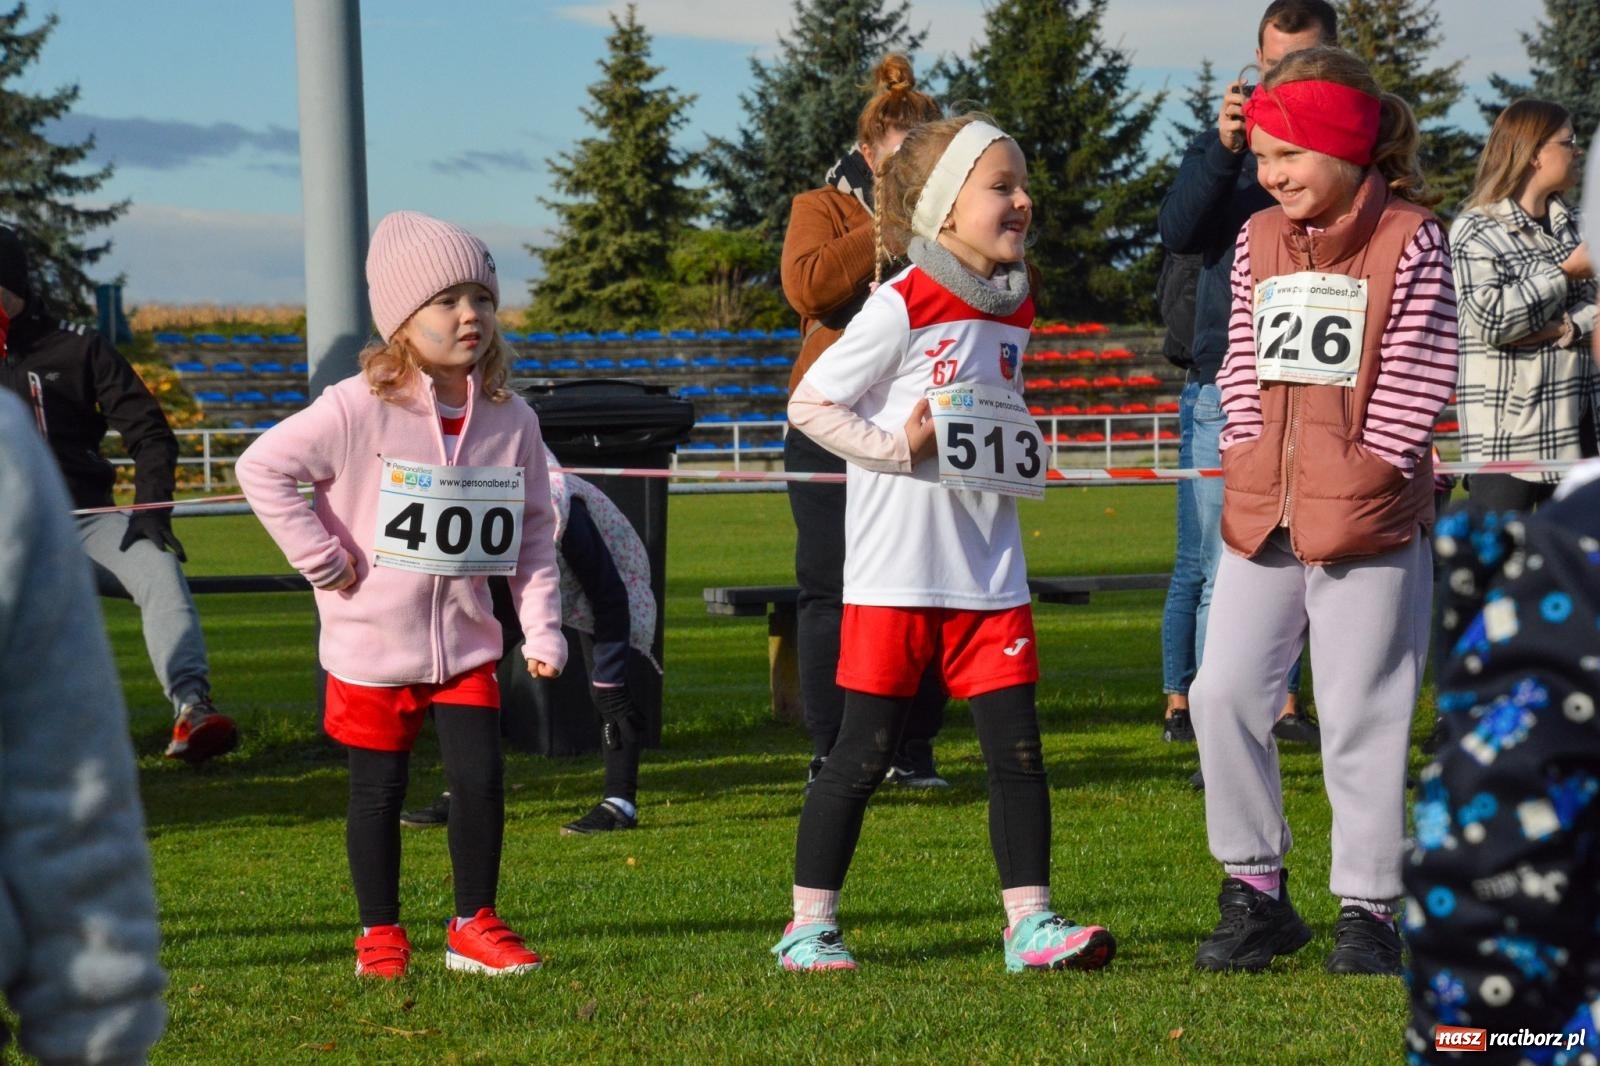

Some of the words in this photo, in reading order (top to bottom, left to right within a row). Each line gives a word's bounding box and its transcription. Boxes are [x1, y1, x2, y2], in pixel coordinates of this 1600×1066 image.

[932, 359, 958, 386] 67
[946, 422, 1041, 479] 513
[439, 479, 520, 490] www.personalbest.pl
[384, 502, 515, 556] 400
